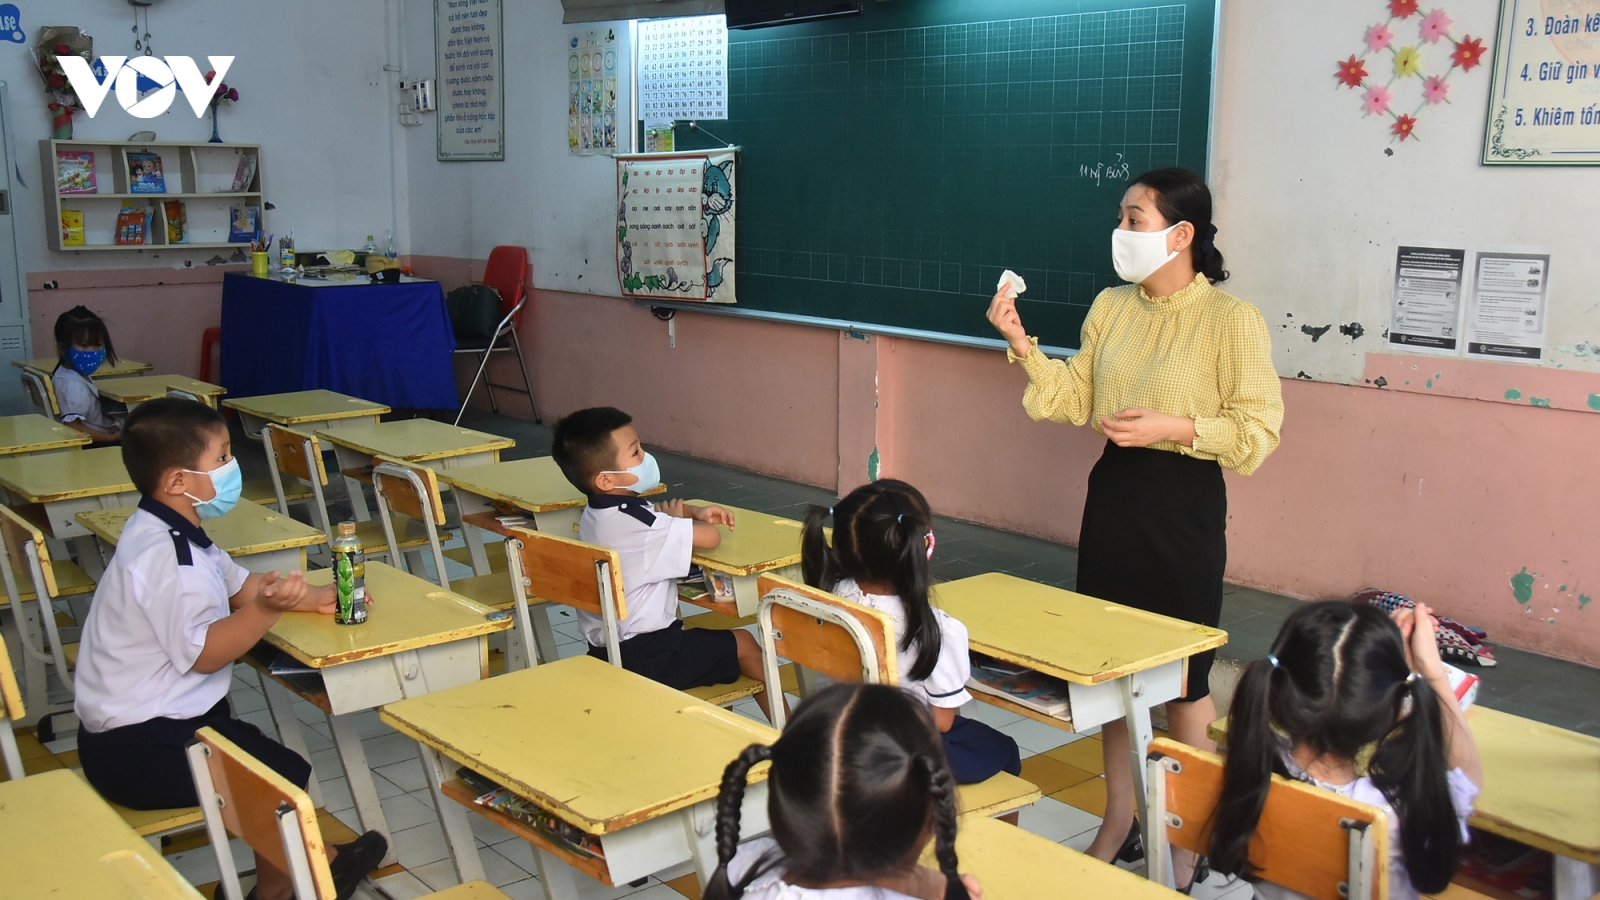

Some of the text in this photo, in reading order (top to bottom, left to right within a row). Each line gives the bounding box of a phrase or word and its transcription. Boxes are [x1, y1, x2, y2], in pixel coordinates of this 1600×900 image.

[1526, 18, 1538, 36] 3.
[1544, 14, 1579, 36] Đoàn
[1520, 63, 1532, 81] 4.
[1539, 61, 1562, 80] Giữ
[1566, 60, 1587, 84] gìn
[1515, 102, 1600, 126] 5. Khiêm tốn
